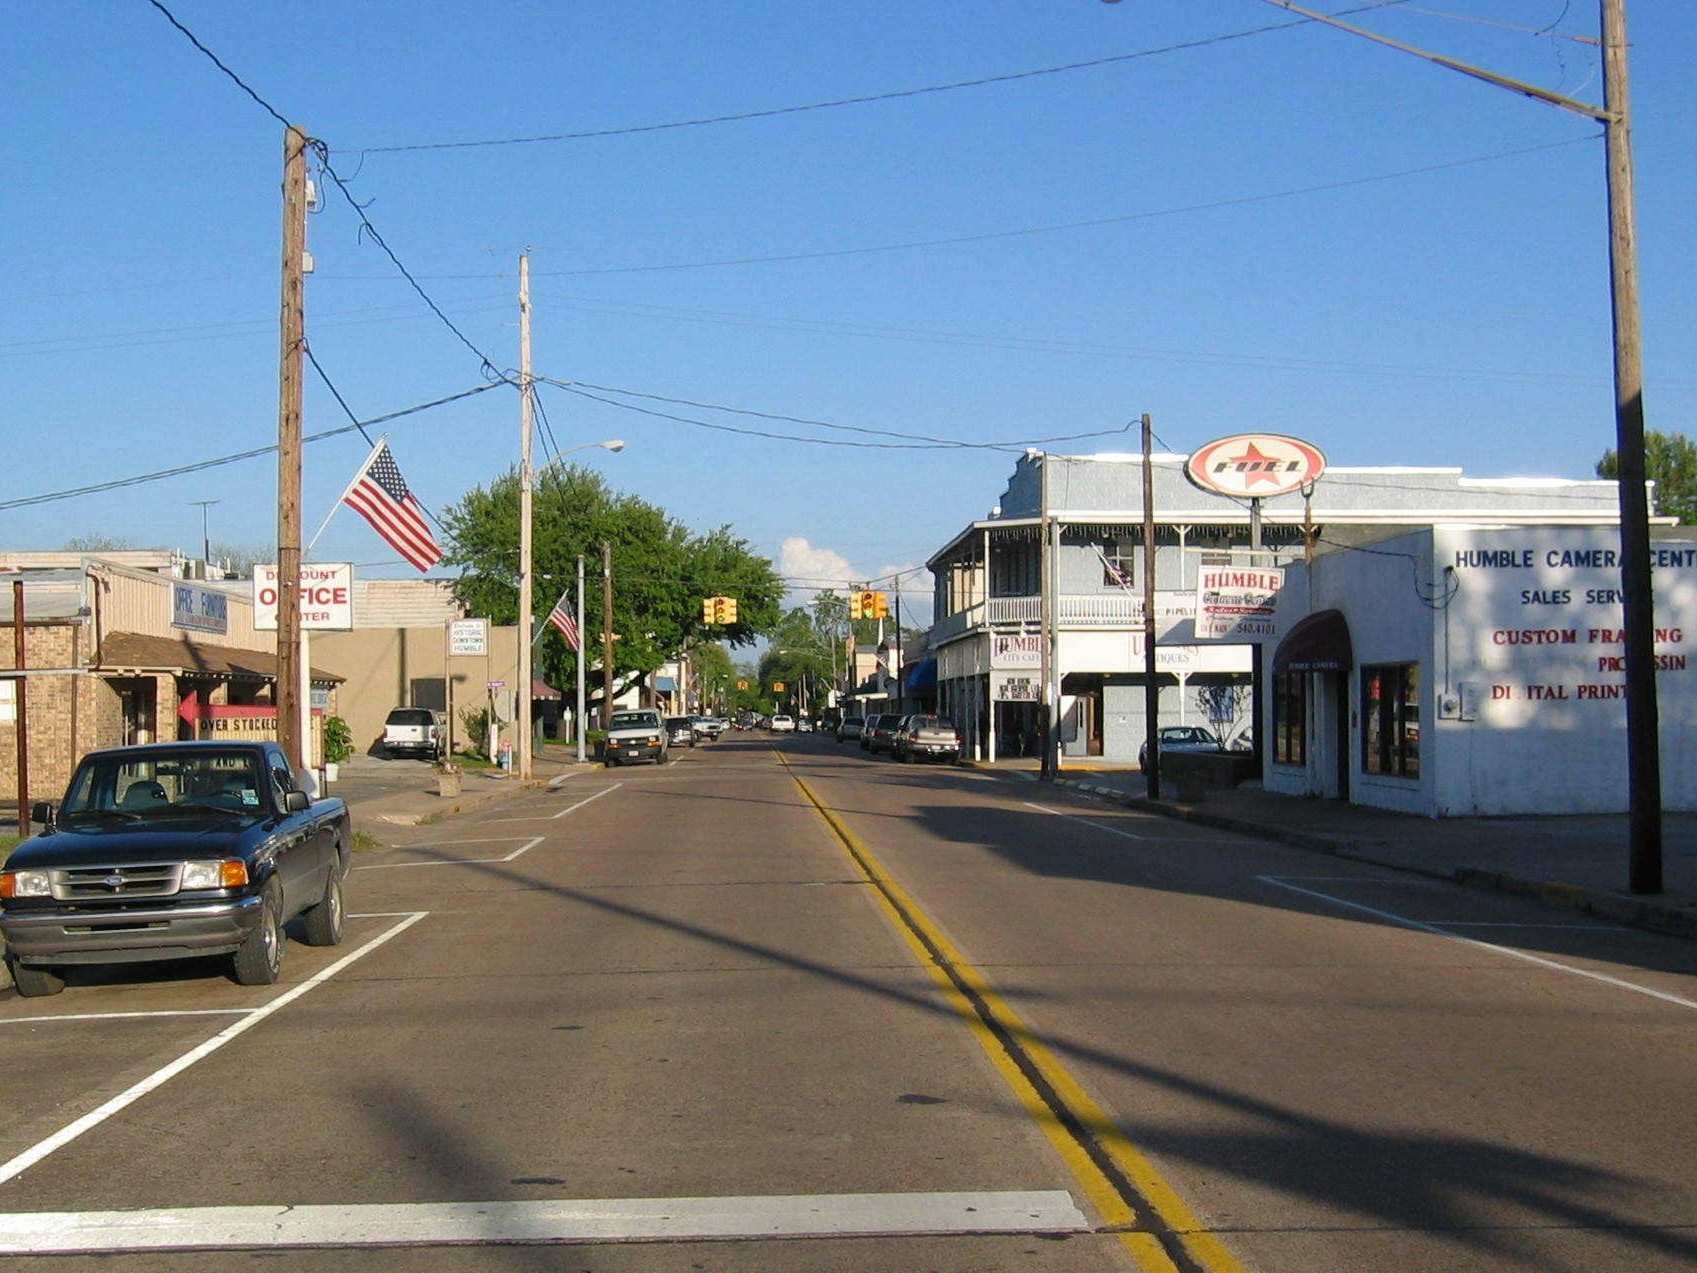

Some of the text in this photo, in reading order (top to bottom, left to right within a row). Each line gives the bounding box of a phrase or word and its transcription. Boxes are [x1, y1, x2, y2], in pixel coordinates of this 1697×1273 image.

[1213, 461, 1301, 473] FUEL
[1455, 550, 1534, 568] HUMBLE
[1650, 549, 1697, 568] CENT
[1204, 572, 1280, 591] HUMBLE
[259, 587, 347, 605] OFICE
[1521, 590, 1571, 604] SALES
[1493, 629, 1682, 645] CUSTOM FRANG
[994, 636, 1041, 656] HUMBL
[200, 718, 278, 730] OVER STOCKED
